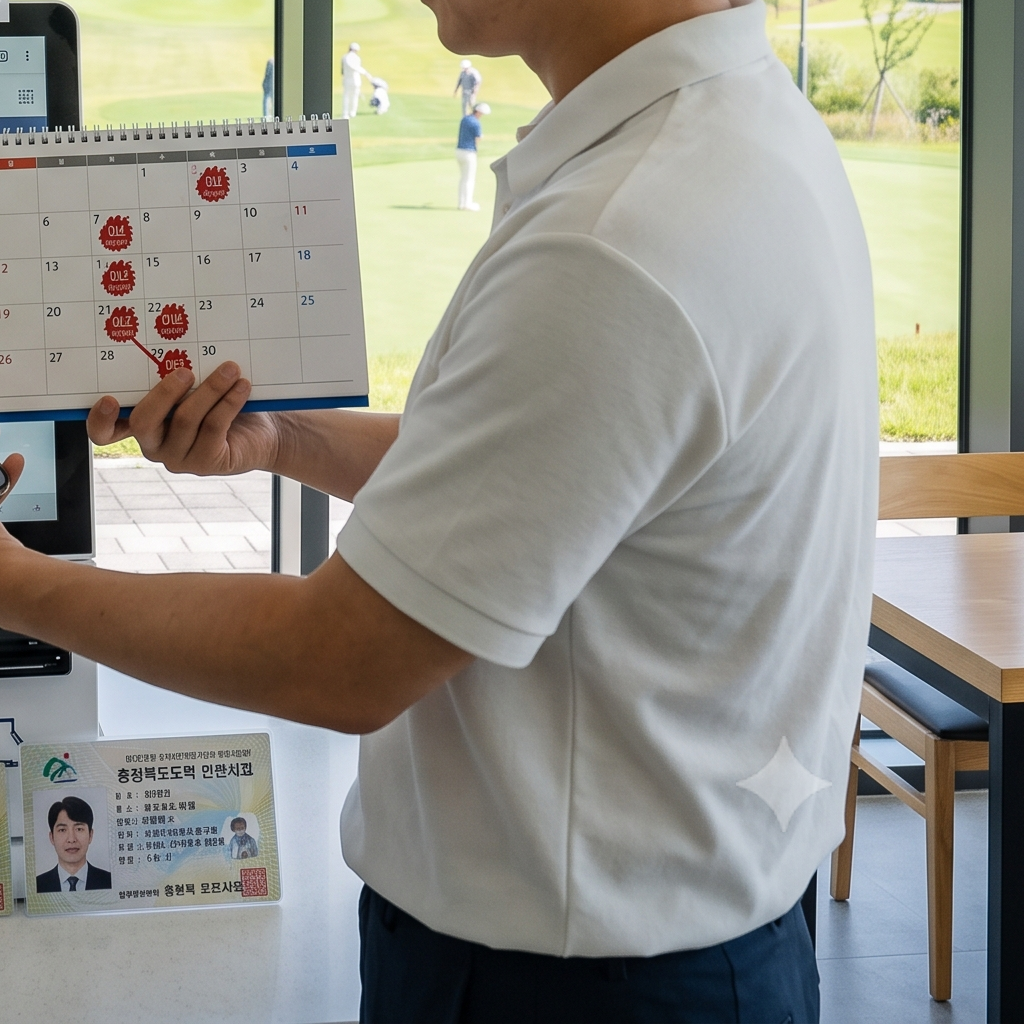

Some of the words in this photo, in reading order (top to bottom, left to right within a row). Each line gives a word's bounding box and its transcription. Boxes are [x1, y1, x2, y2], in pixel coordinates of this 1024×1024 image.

[241, 163, 246, 172] 3
[292, 161, 298, 170] 4
[142, 168, 145, 177] 1
[194, 210, 200, 220] 9
[244, 208, 257, 217] 10
[295, 206, 306, 215] 11
[43, 217, 49, 226] 6
[94, 215, 99, 224] 7
[144, 212, 149, 222] 8
[249, 253, 261, 262] 17
[298, 250, 310, 259] 18
[147, 257, 159, 267] 15
[197, 255, 210, 264] 16
[46, 262, 58, 271] 13
[200, 300, 212, 310] 23
[251, 298, 264, 307] 24
[302, 296, 314, 305] 25
[47, 307, 61, 316] 20
[99, 305, 110, 314] 21
[148, 303, 161, 312] 22
[152, 348, 163, 358] 29
[203, 346, 215, 355] 30
[0, 355, 12, 364] 26
[50, 353, 62, 362] 27
[101, 351, 114, 360] 28
